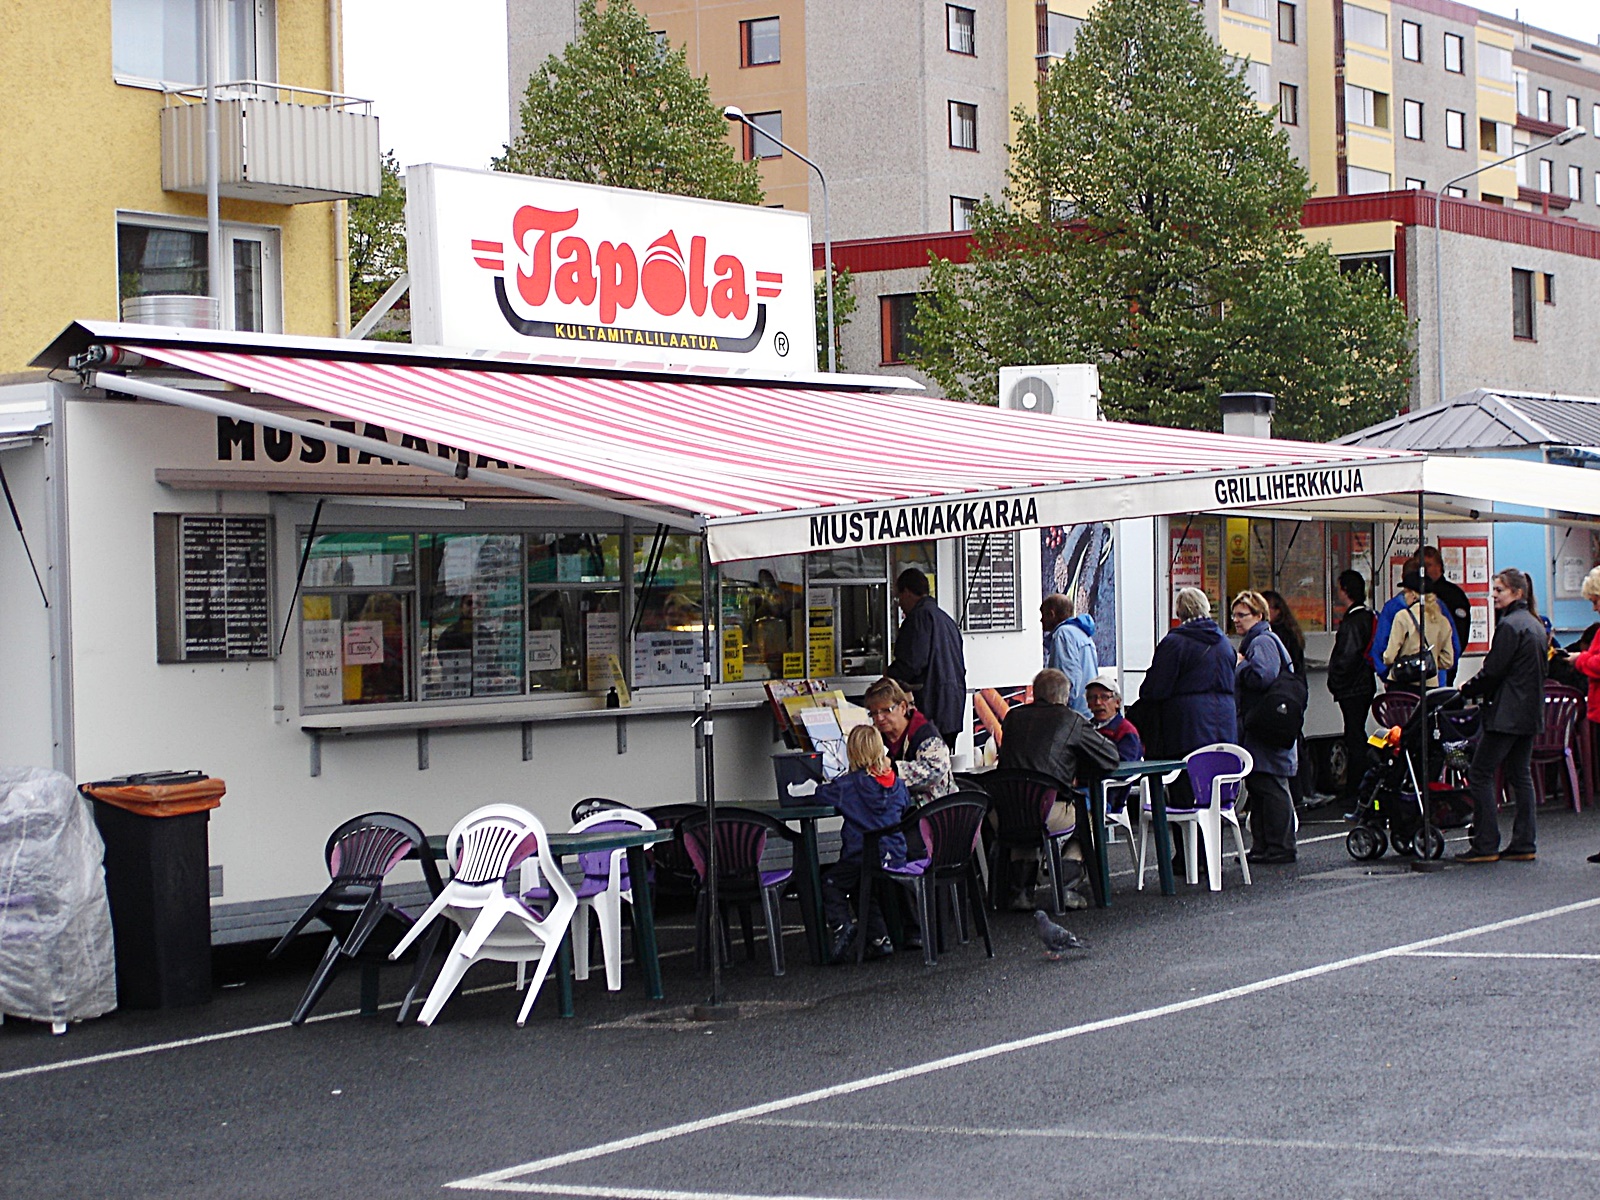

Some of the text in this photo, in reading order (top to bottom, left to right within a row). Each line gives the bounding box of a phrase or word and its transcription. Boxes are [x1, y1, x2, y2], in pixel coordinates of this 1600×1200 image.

[555, 323, 719, 351] KULTAMITALILAATUA
[1214, 468, 1365, 505] GRILLIHERKKUJA
[809, 496, 1039, 547] MUSTAAMAKKARAA
